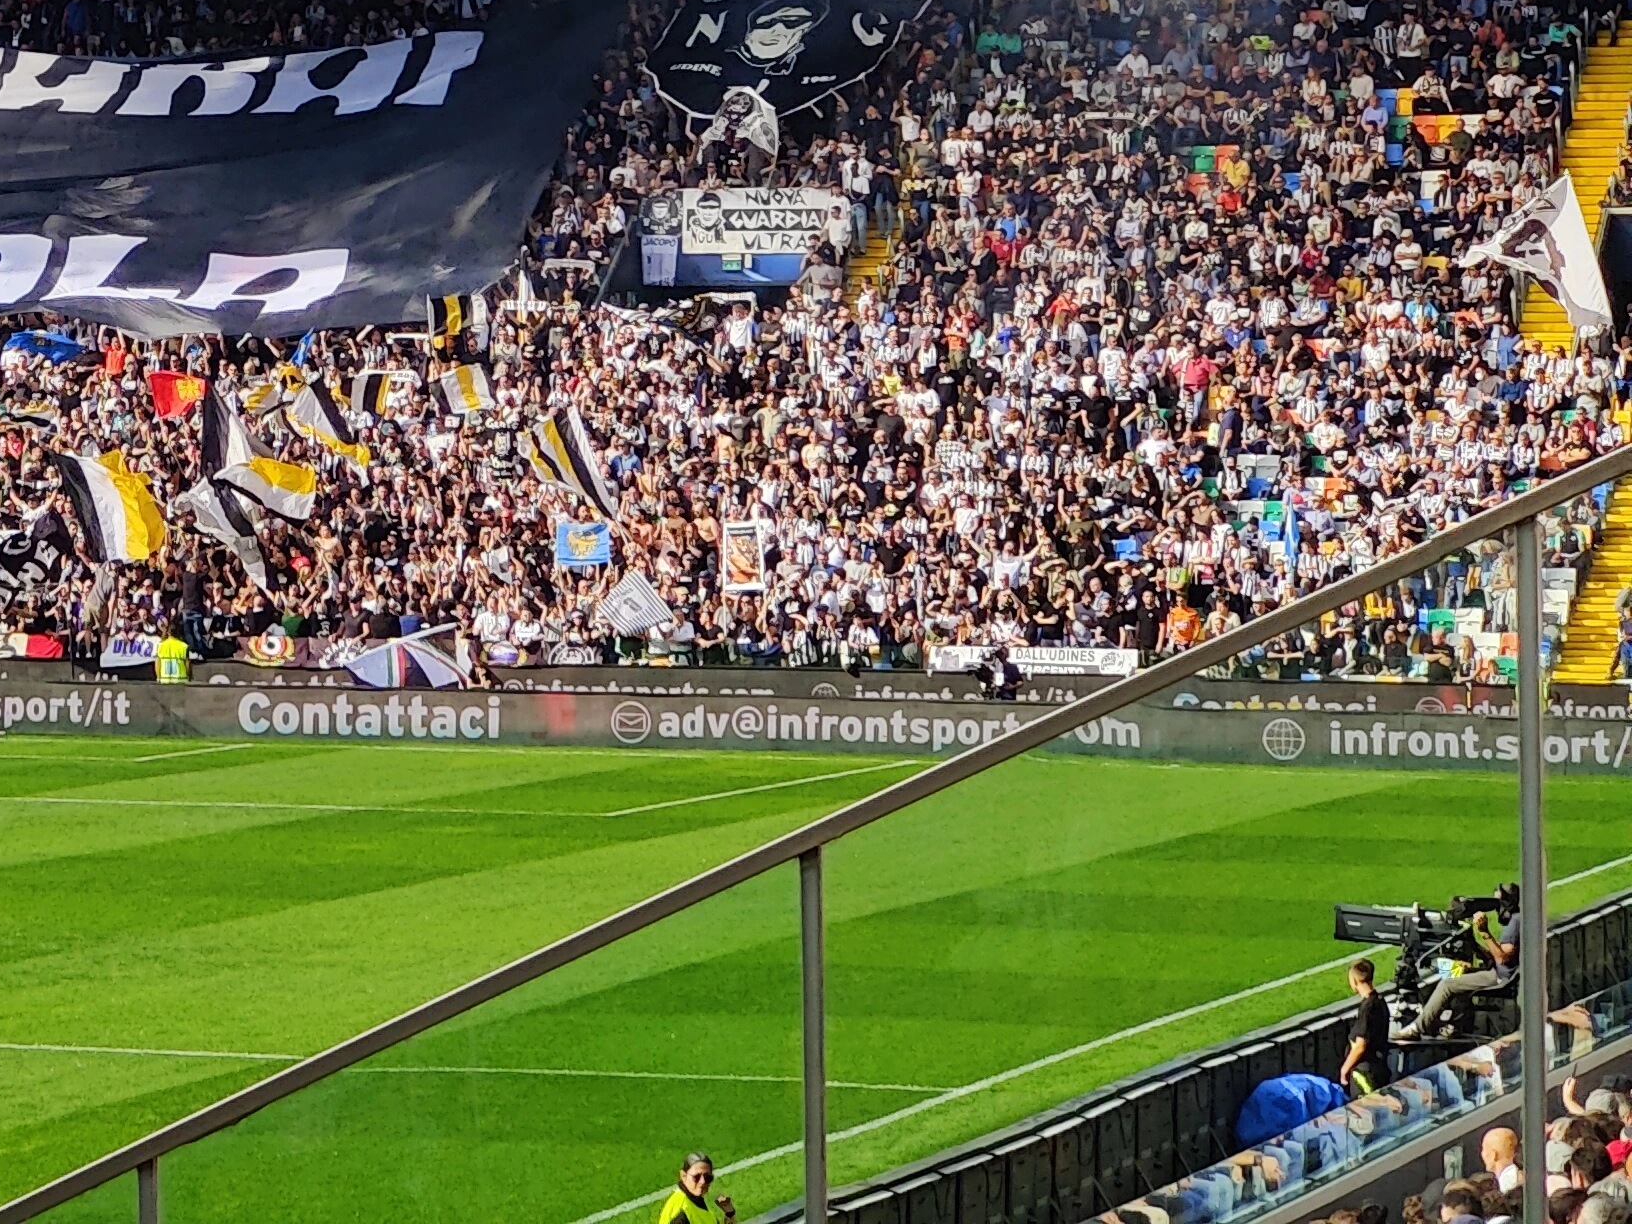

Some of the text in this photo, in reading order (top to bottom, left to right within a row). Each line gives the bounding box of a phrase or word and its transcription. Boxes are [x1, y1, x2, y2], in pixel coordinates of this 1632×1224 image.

[685, 10, 728, 47] N
[745, 189, 808, 206] NUOVA
[728, 209, 823, 229] GUARDIA
[643, 237, 677, 247] JACOPO
[238, 692, 501, 739] Contattaci
[658, 704, 1141, 752] adv@infrontsportom
[1330, 719, 1632, 768] infront.sort/
